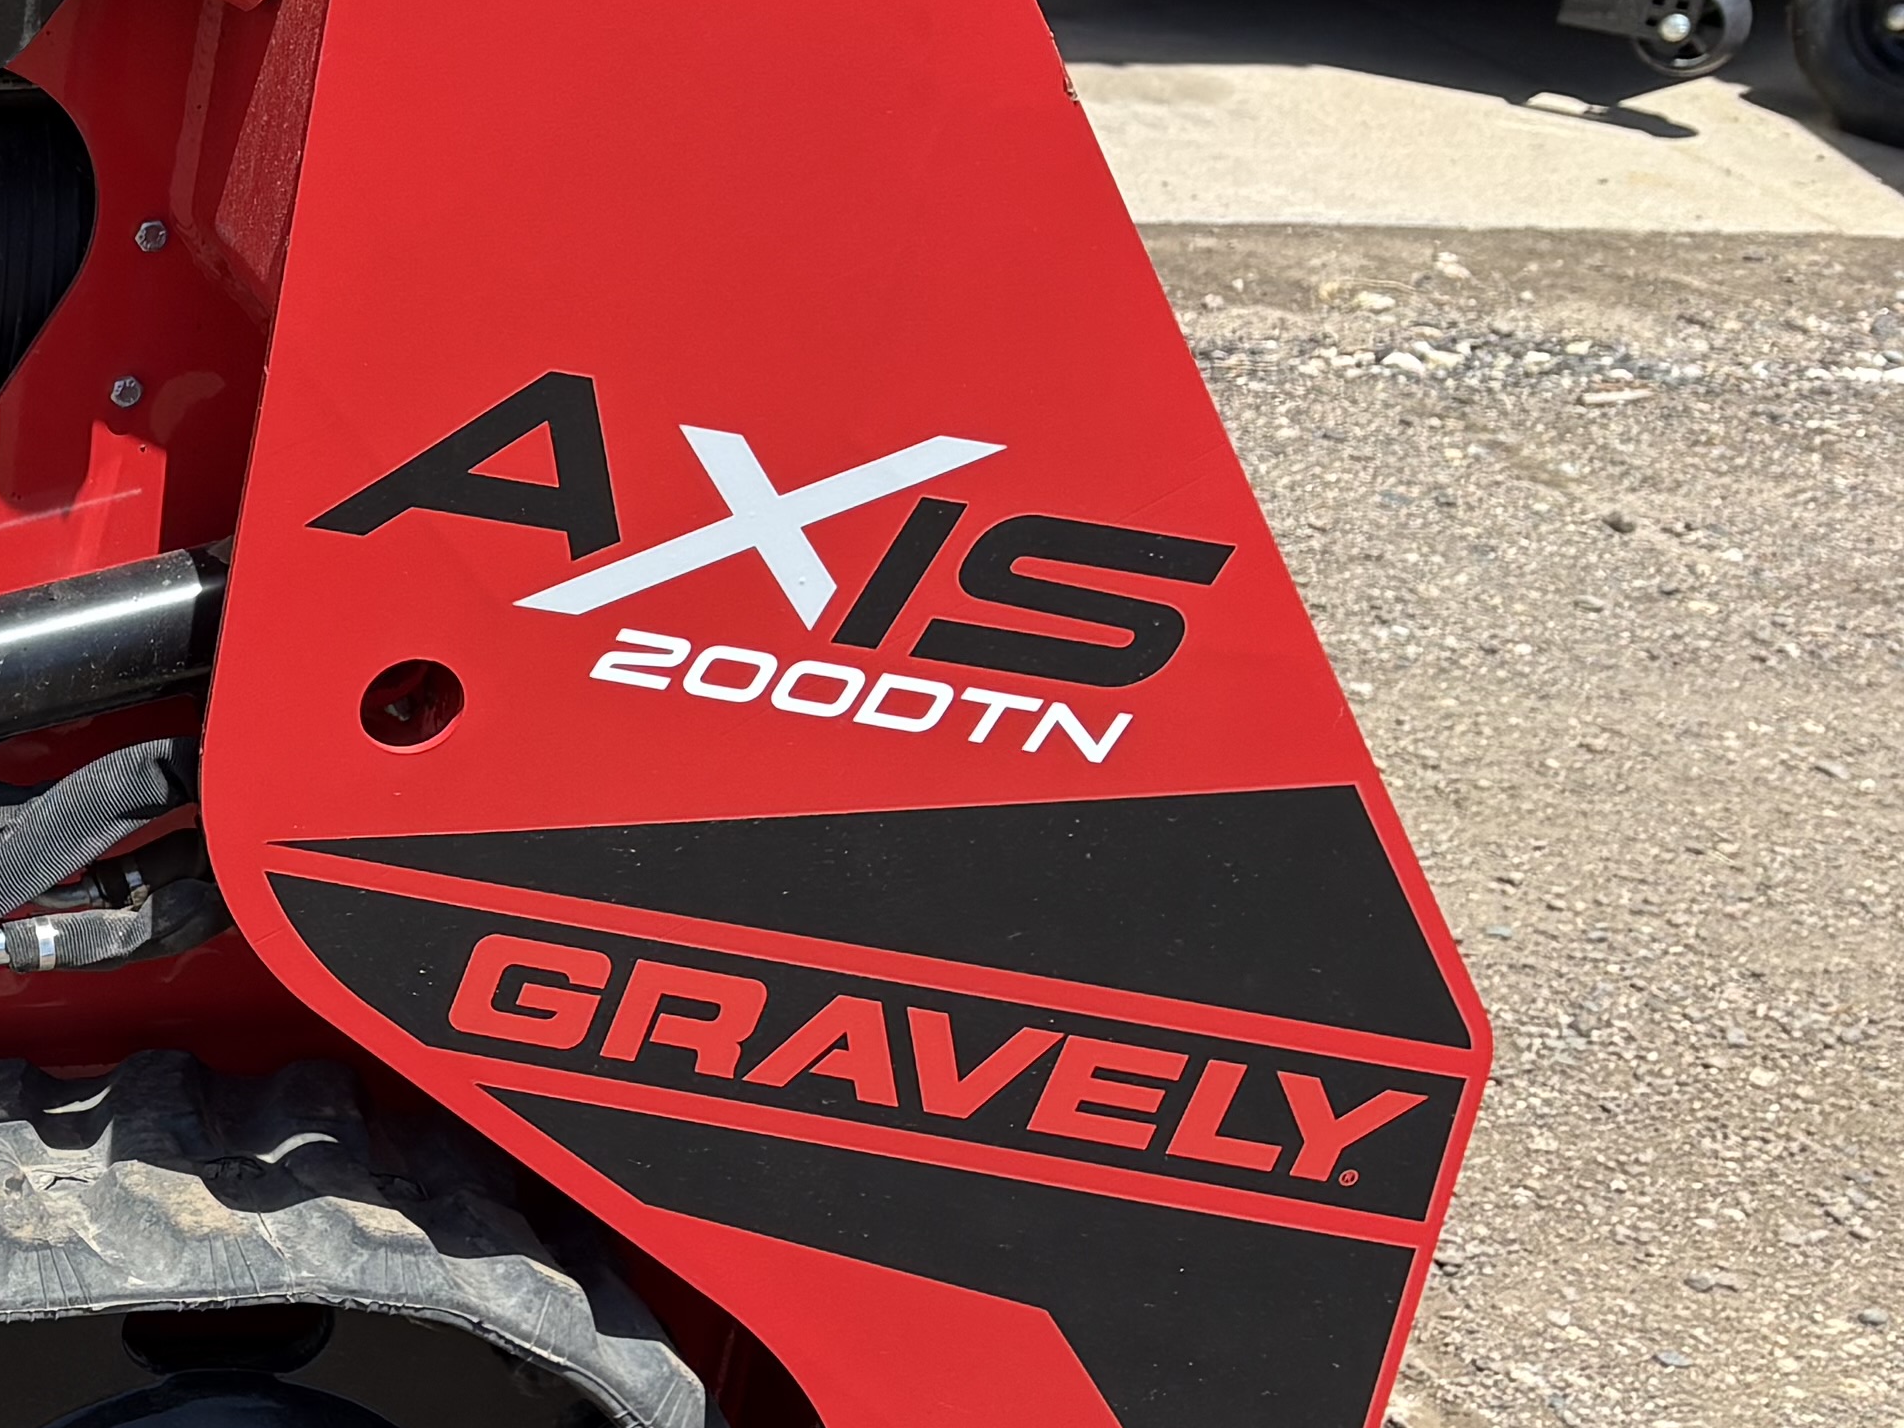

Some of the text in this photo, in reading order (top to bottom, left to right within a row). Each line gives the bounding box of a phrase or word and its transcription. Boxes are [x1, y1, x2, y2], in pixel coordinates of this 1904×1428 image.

[305, 371, 1237, 689] AXIS
[589, 627, 1134, 764] 200DTN
[447, 931, 1429, 1183] GRAVELY
